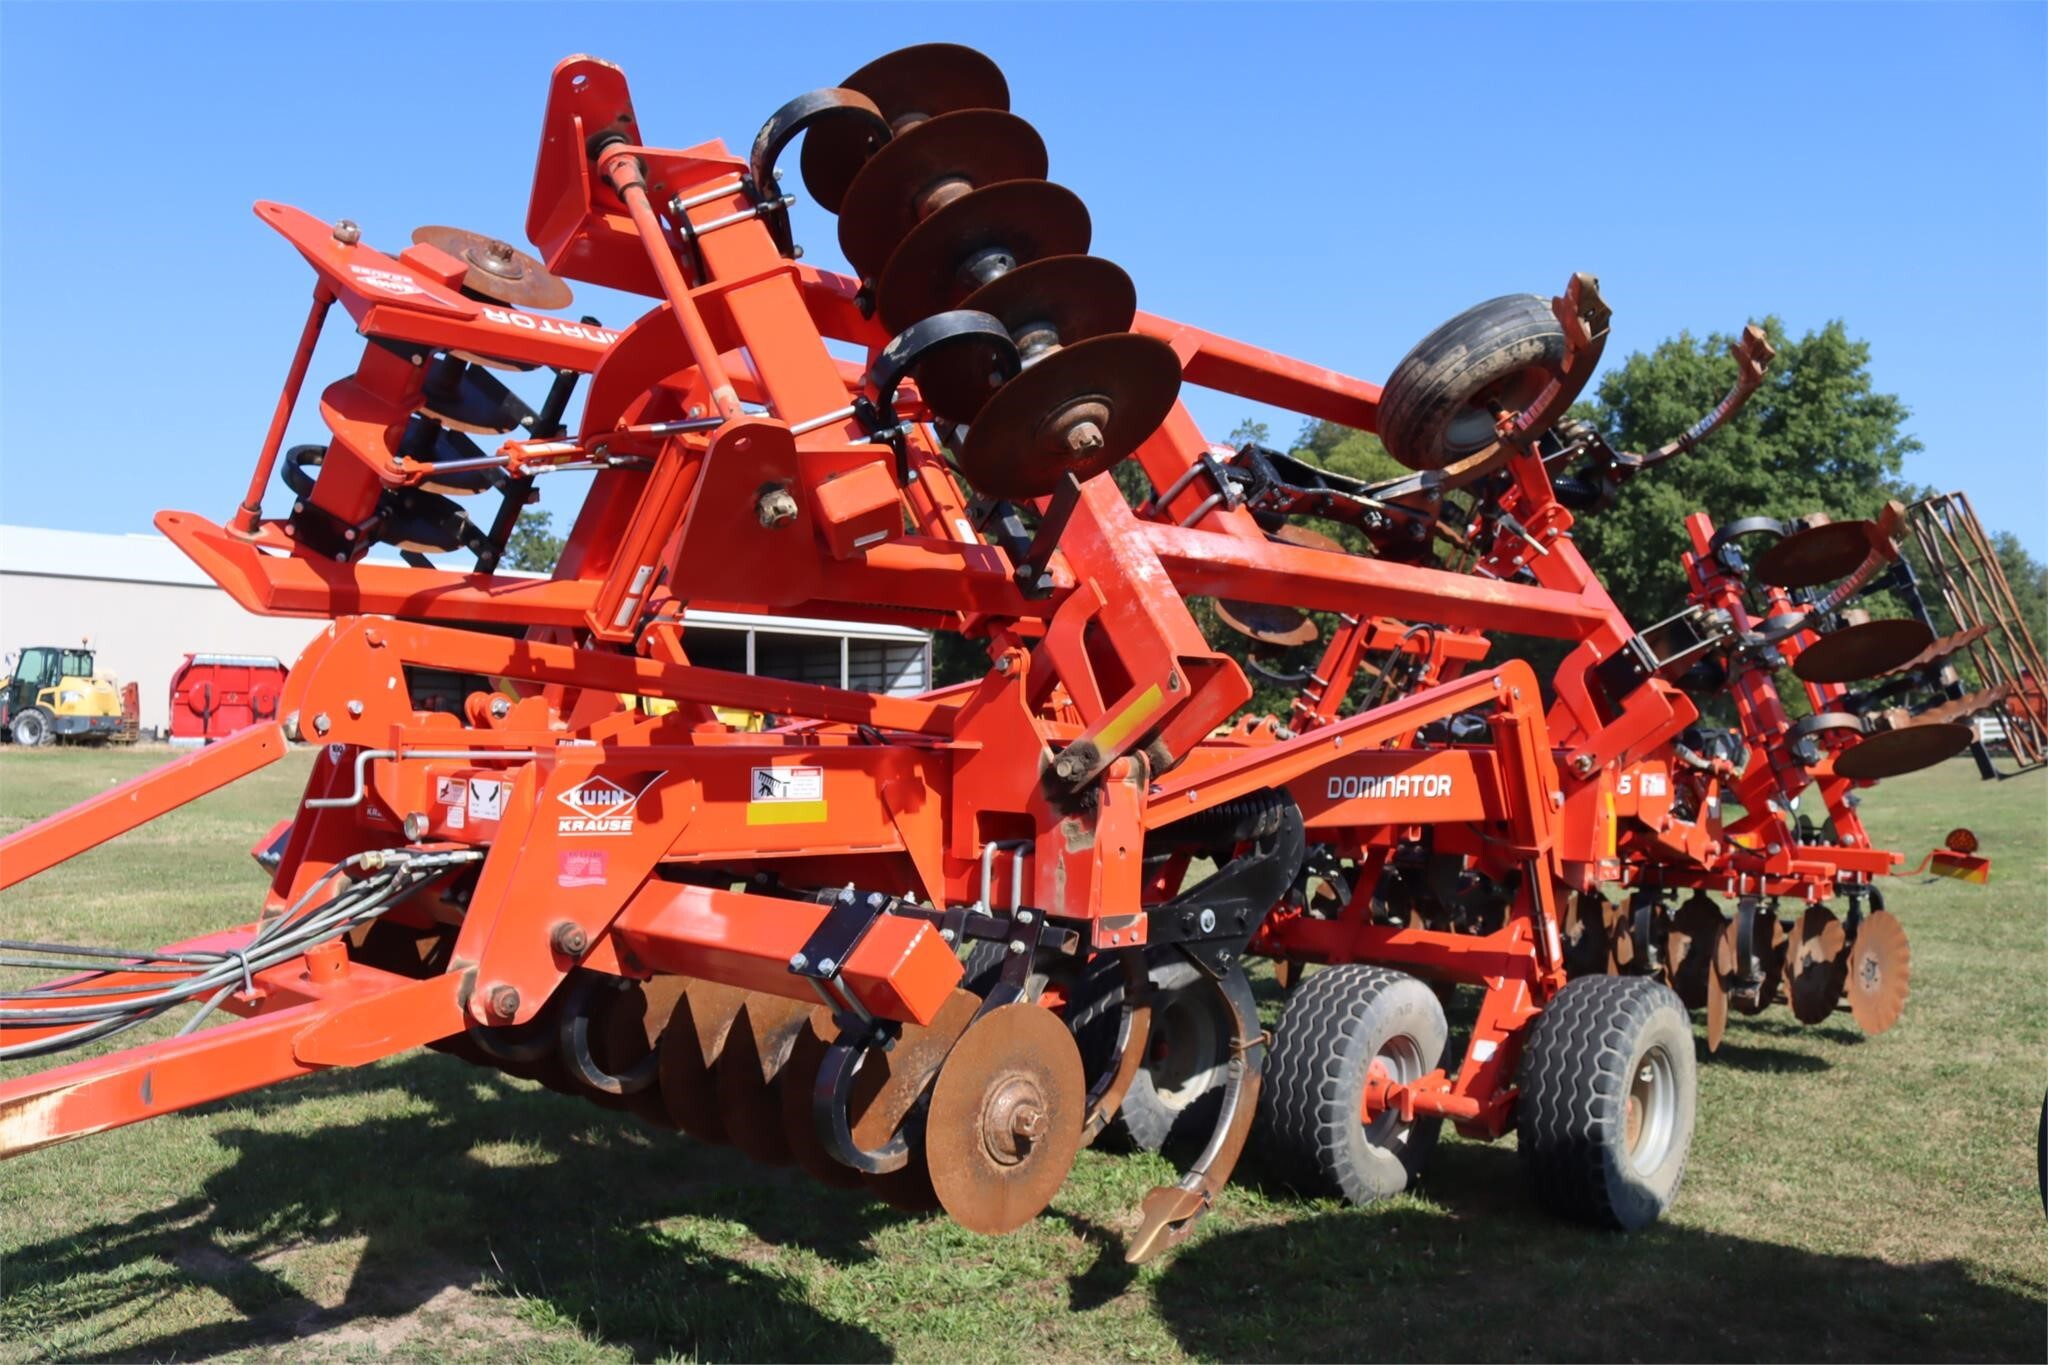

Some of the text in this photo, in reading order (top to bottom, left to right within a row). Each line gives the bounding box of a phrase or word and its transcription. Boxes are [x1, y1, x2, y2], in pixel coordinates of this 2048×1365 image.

[483, 307, 618, 344] INATOR
[1327, 775, 1452, 798] DOMINATOR
[569, 790, 625, 806] KUHN
[558, 820, 633, 832] KRAUSE
